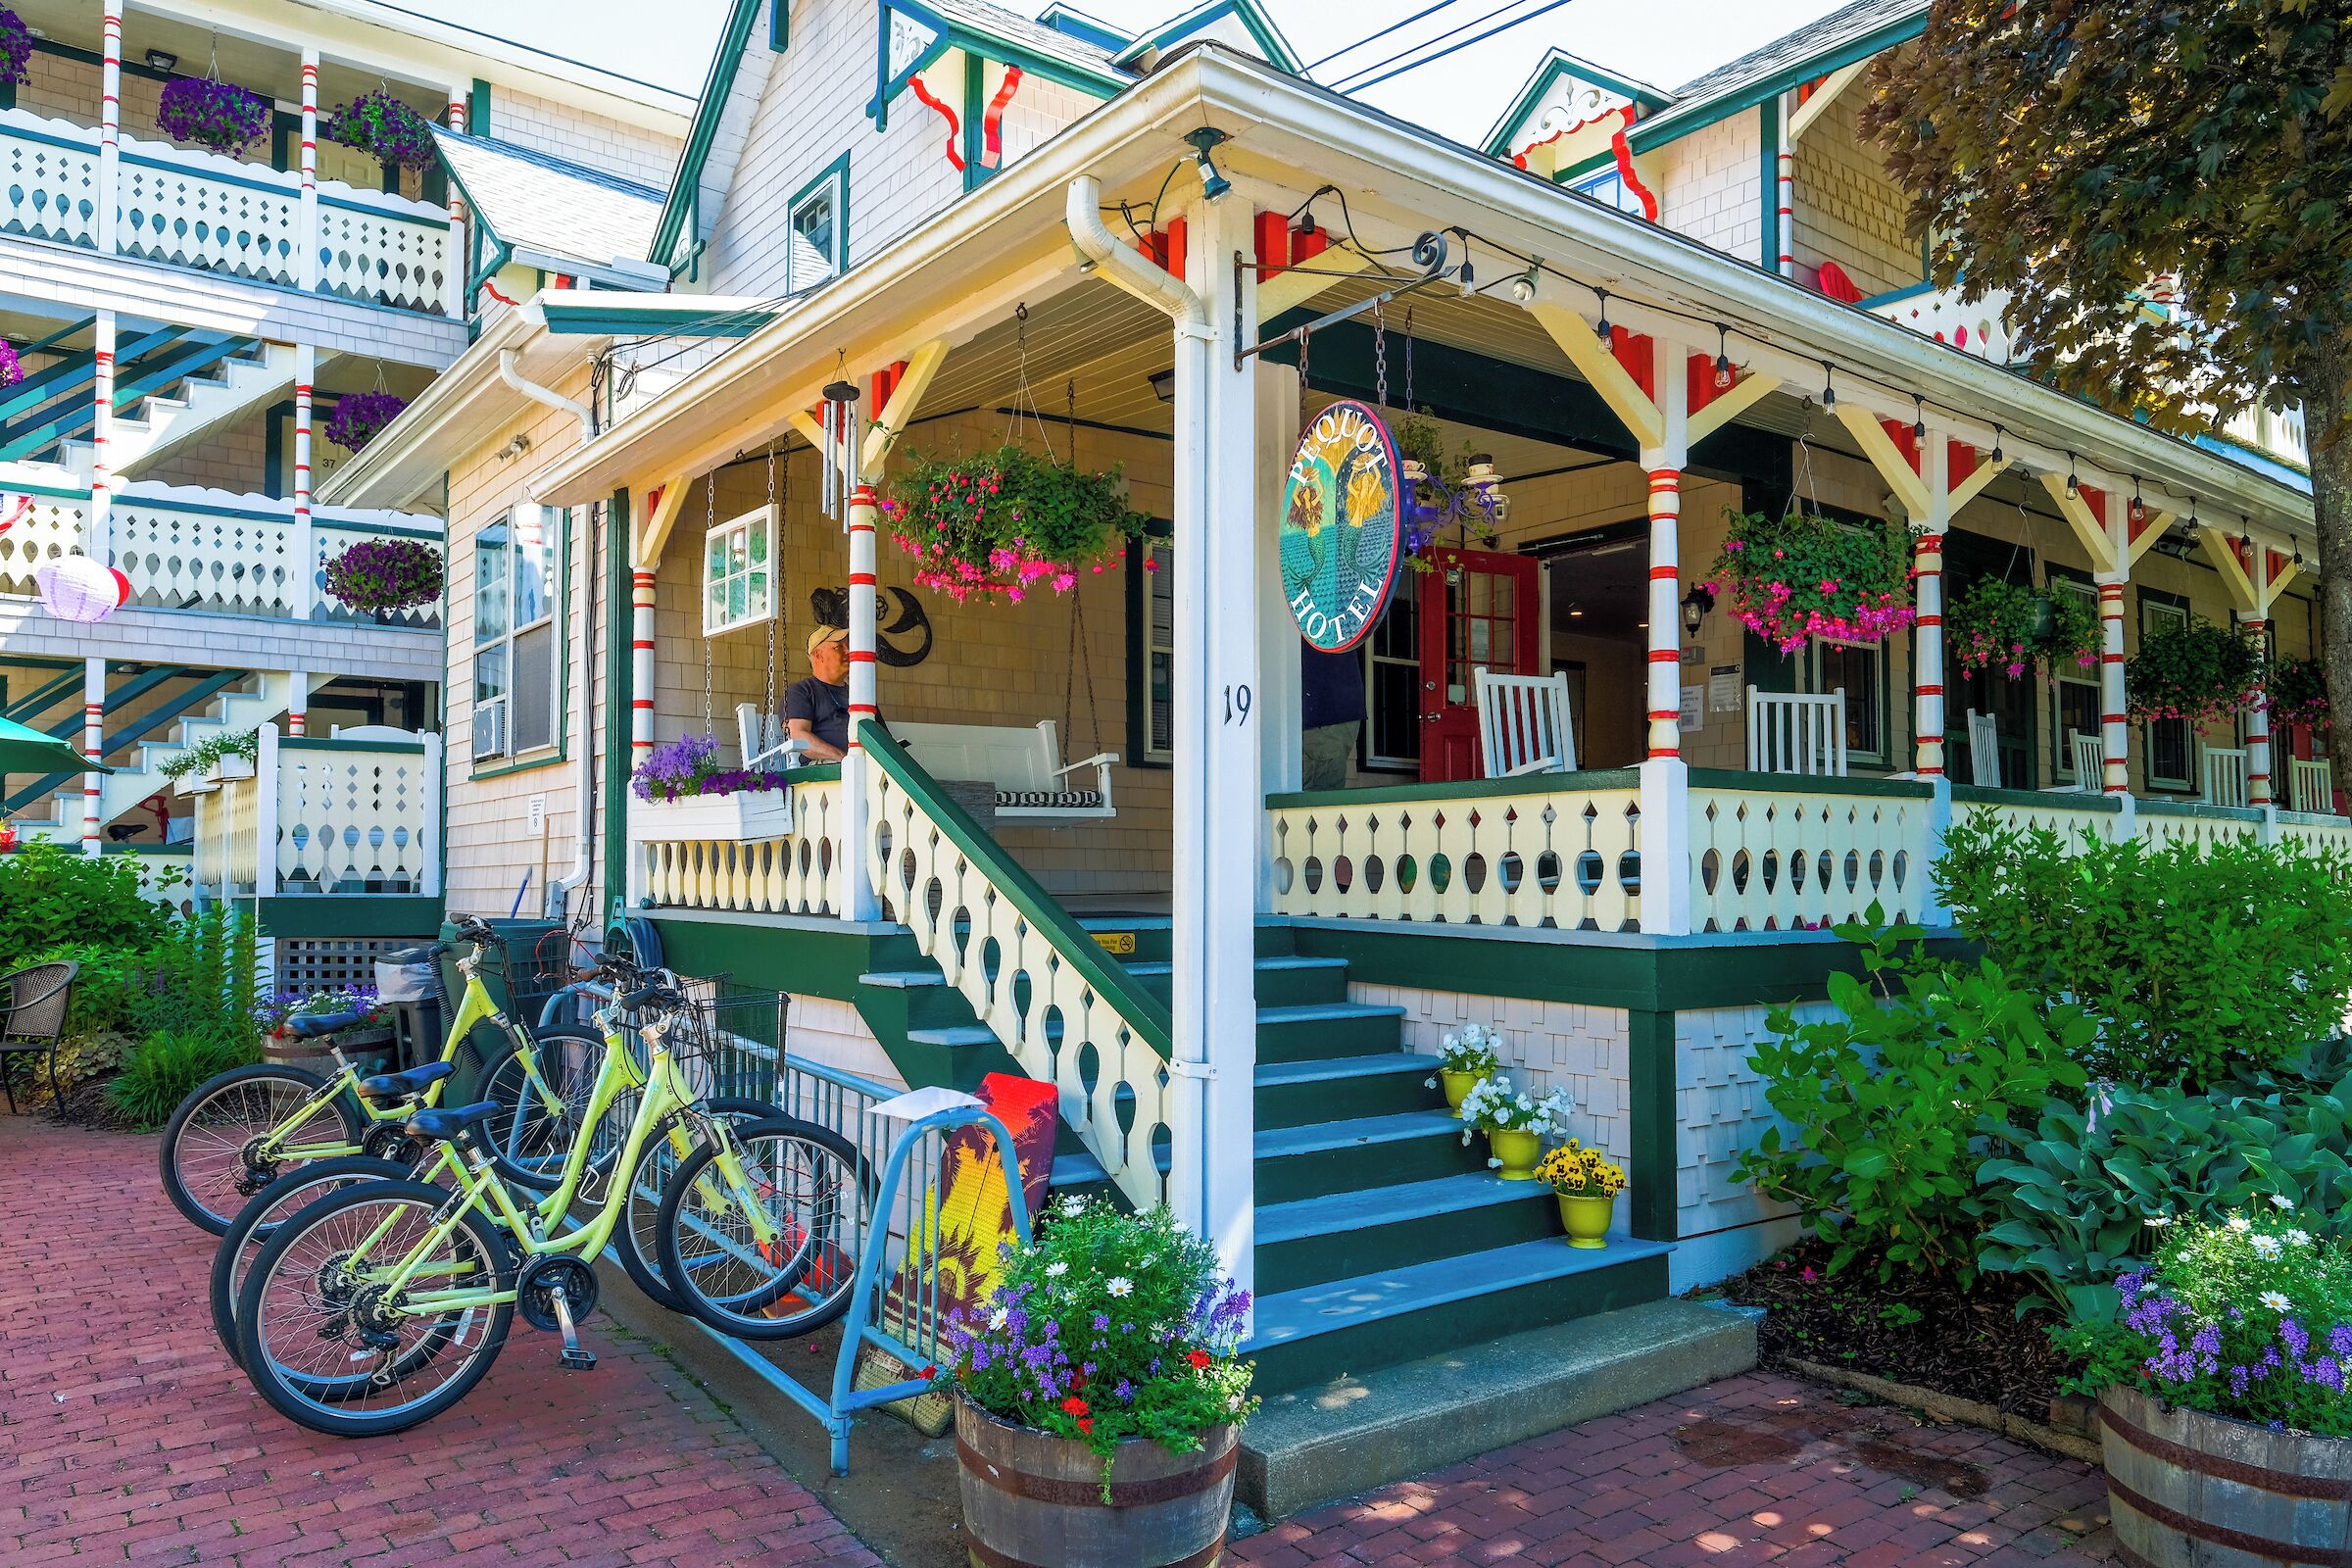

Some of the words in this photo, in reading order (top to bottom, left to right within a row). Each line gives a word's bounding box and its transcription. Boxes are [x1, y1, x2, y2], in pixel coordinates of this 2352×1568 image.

[322, 458, 336, 468] 37
[1289, 408, 1388, 487] PEQUOT
[1291, 579, 1383, 644] HOTEL
[1224, 684, 1251, 727] 19
